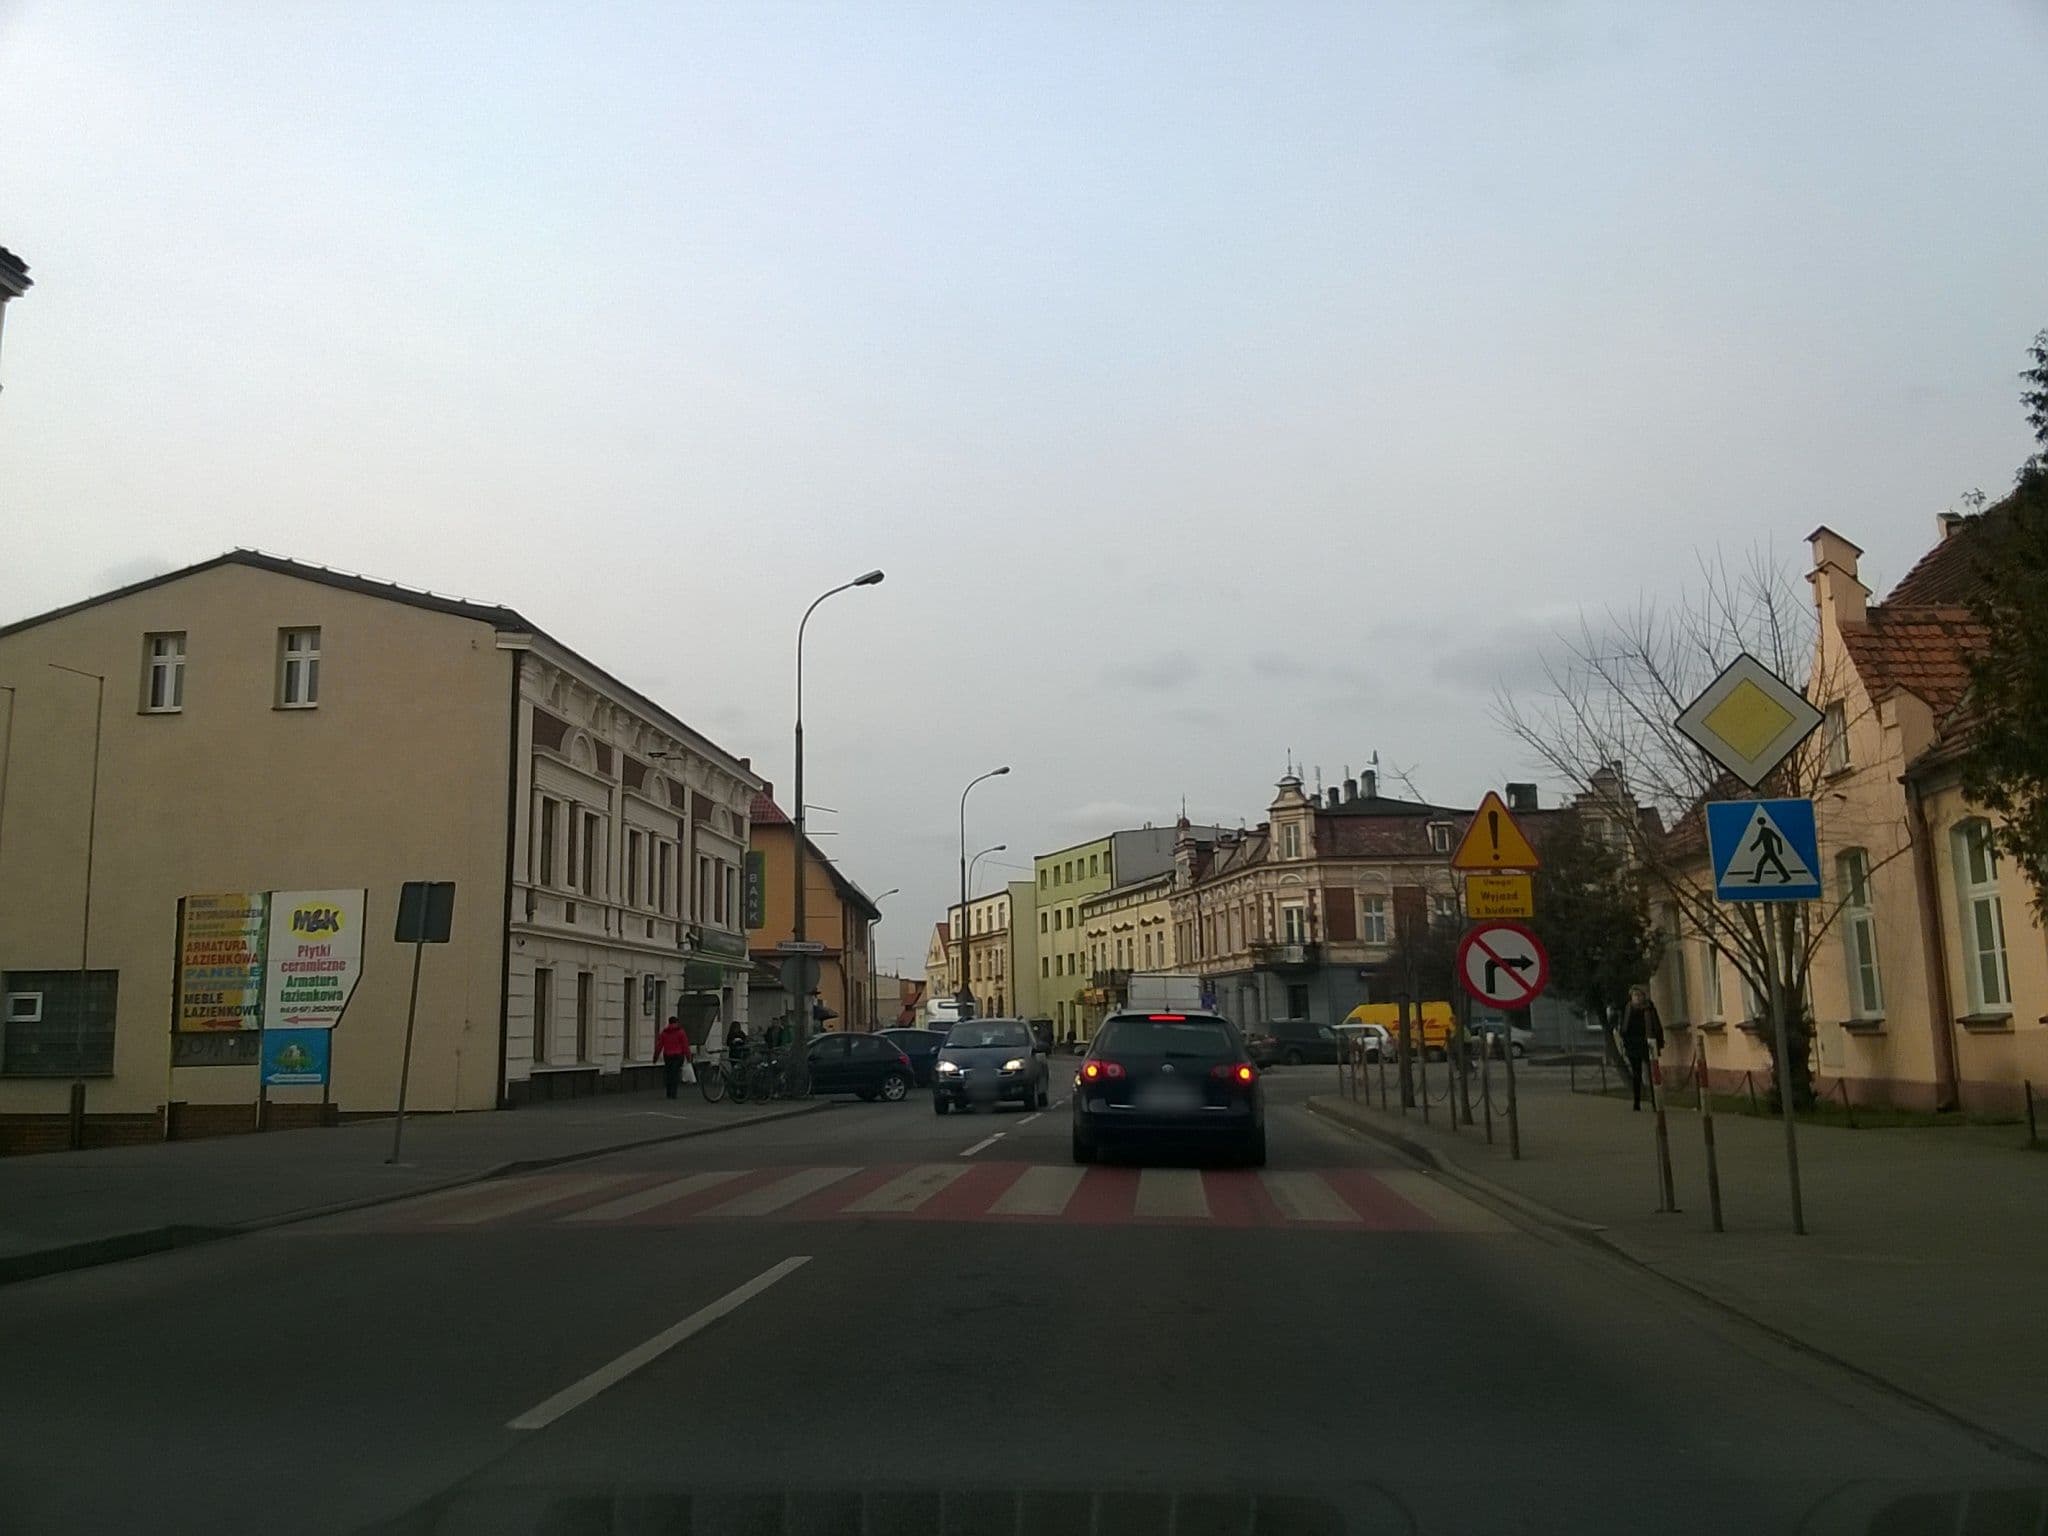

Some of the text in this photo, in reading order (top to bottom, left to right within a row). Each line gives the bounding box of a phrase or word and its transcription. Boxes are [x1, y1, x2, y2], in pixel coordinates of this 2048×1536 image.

[749, 873, 759, 921] BANK
[1480, 891, 1518, 902] Wyjazd
[292, 908, 340, 933] M&K
[185, 940, 248, 952] ARMATURA
[298, 944, 331, 958] Płytki
[185, 952, 259, 966] ŁAZIENKOWA
[281, 959, 346, 973] ceramiczne
[185, 967, 262, 979] PANELE
[286, 975, 338, 988] Armatura
[184, 992, 223, 1005] MEBLE
[280, 988, 344, 1002] łazienkowa
[184, 1004, 261, 1018] ŁAZIENKOWE
